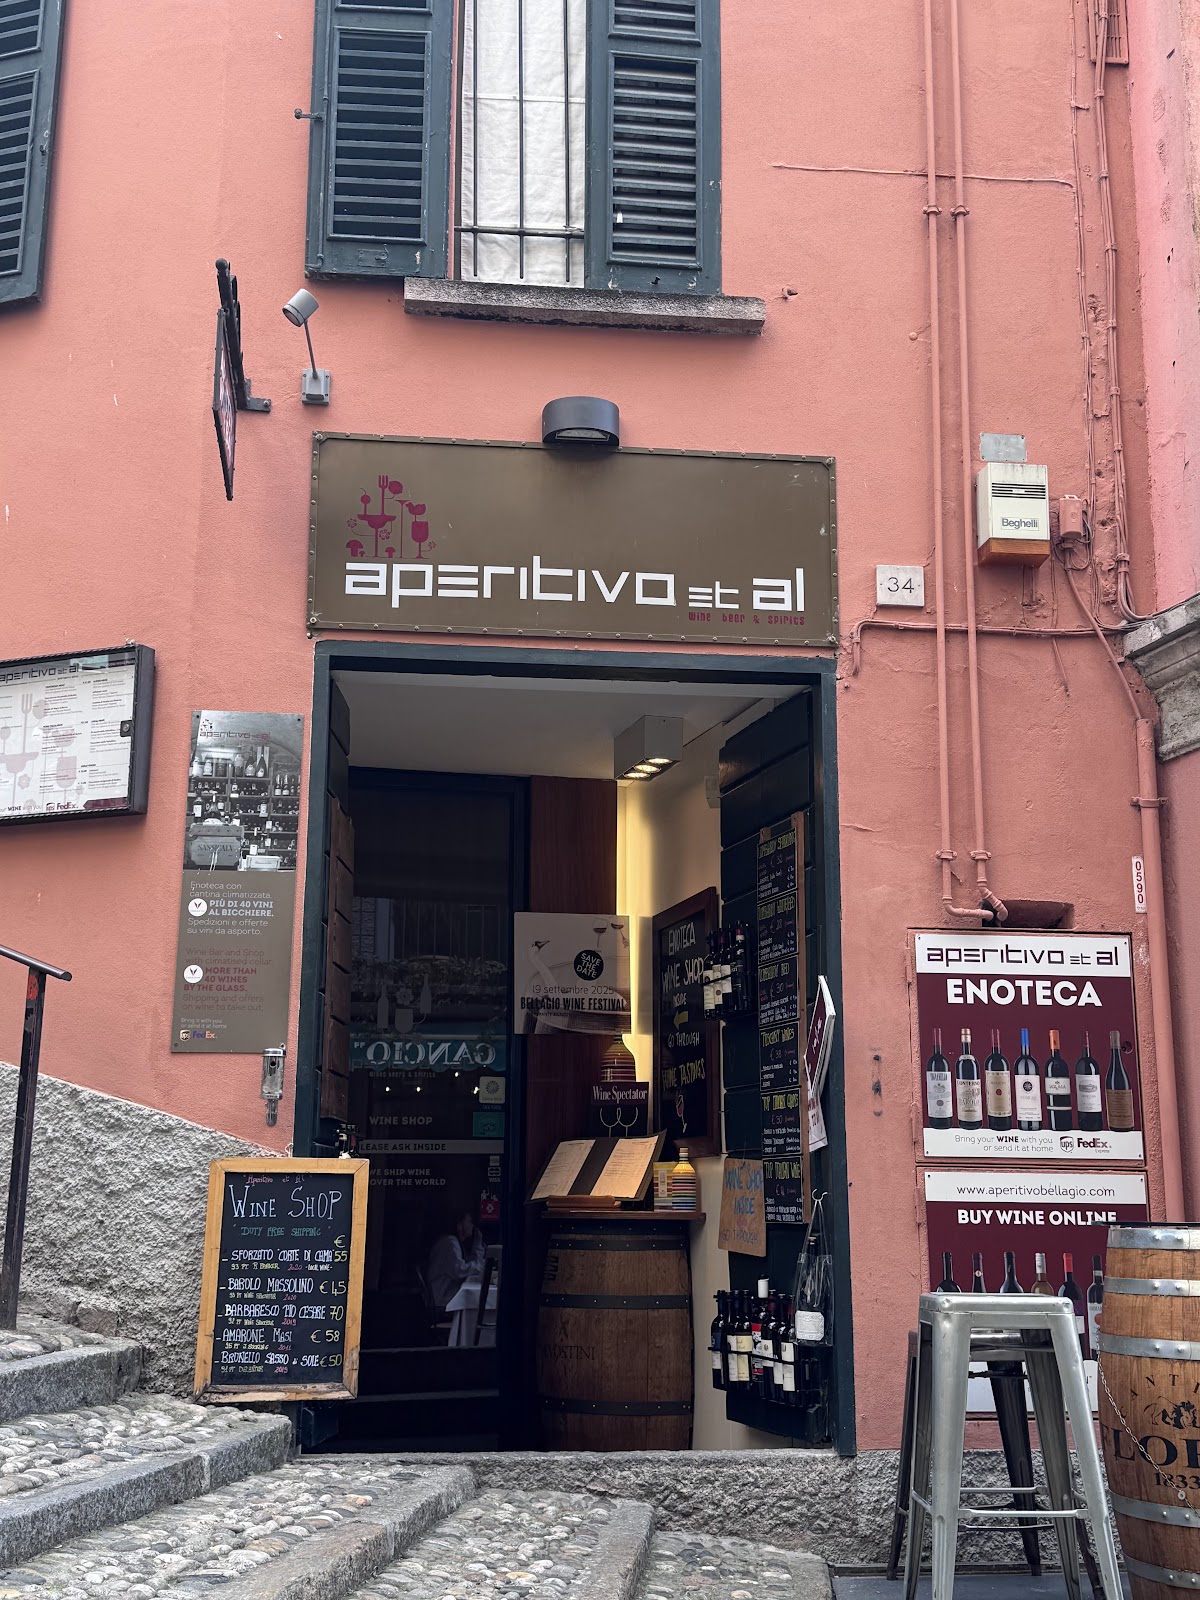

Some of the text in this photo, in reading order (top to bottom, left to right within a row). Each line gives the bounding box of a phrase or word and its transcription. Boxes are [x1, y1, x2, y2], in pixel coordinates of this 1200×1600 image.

[1002, 518, 1038, 530] Beghelli
[345, 556, 675, 608] aperitivo
[752, 568, 804, 611] al
[887, 577, 914, 594] 34
[688, 612, 805, 626] wine beer & spirits
[222, 909, 274, 917] BICCHIERE.
[188, 918, 230, 926] Spedizioni
[227, 928, 262, 936] asporto.
[668, 922, 696, 956] ENOTECA
[186, 948, 206, 956] Wine
[209, 948, 224, 956] Bar
[243, 949, 264, 957] Shop
[581, 952, 601, 966] SAVE
[927, 944, 1064, 967] aperitivo
[1097, 947, 1118, 965] al
[576, 965, 597, 978] DATE
[582, 961, 597, 971] THE
[662, 963, 681, 994] WINE
[684, 956, 704, 986] SHOP
[532, 985, 615, 994] 19 settembre 2025
[946, 978, 1102, 1006] ENOTECA
[183, 994, 263, 1003] Shipping and offers
[520, 997, 625, 1011] BELLAGIO WINE FESTIVAL
[668, 1031, 700, 1048] GO THROUGH
[679, 1058, 705, 1088] TASTINGS
[592, 1085, 647, 1104] Wine Spectator
[369, 1116, 432, 1125] WINE SHOP
[955, 1135, 976, 1144] Bring
[977, 1136, 994, 1144] your
[1021, 1136, 1037, 1144] with
[1077, 1138, 1108, 1148] FedEx
[957, 1184, 1115, 1199] www.aperitivobellagio.com
[288, 1186, 342, 1220] SHOP
[958, 1209, 1116, 1225] BUY WINE ONLINE
[241, 1227, 321, 1236] DUTY FREE SHIPPING
[334, 1235, 346, 1248] €
[231, 1249, 274, 1260] SFORZATO
[304, 1250, 311, 1260] DI
[334, 1251, 348, 1262] 55
[228, 1278, 346, 1296] BAROLO MASSOLINO € 45
[224, 1304, 280, 1317] BARBARESCO
[299, 1306, 326, 1319] CESARE
[329, 1305, 344, 1320] 70
[222, 1328, 340, 1343] AMARONE MASI € 58
[221, 1351, 260, 1364] BRUNELLO
[265, 1352, 289, 1364] SASSO
[300, 1355, 319, 1366] SOLE
[319, 1356, 327, 1367] €
[328, 1354, 342, 1366] 50
